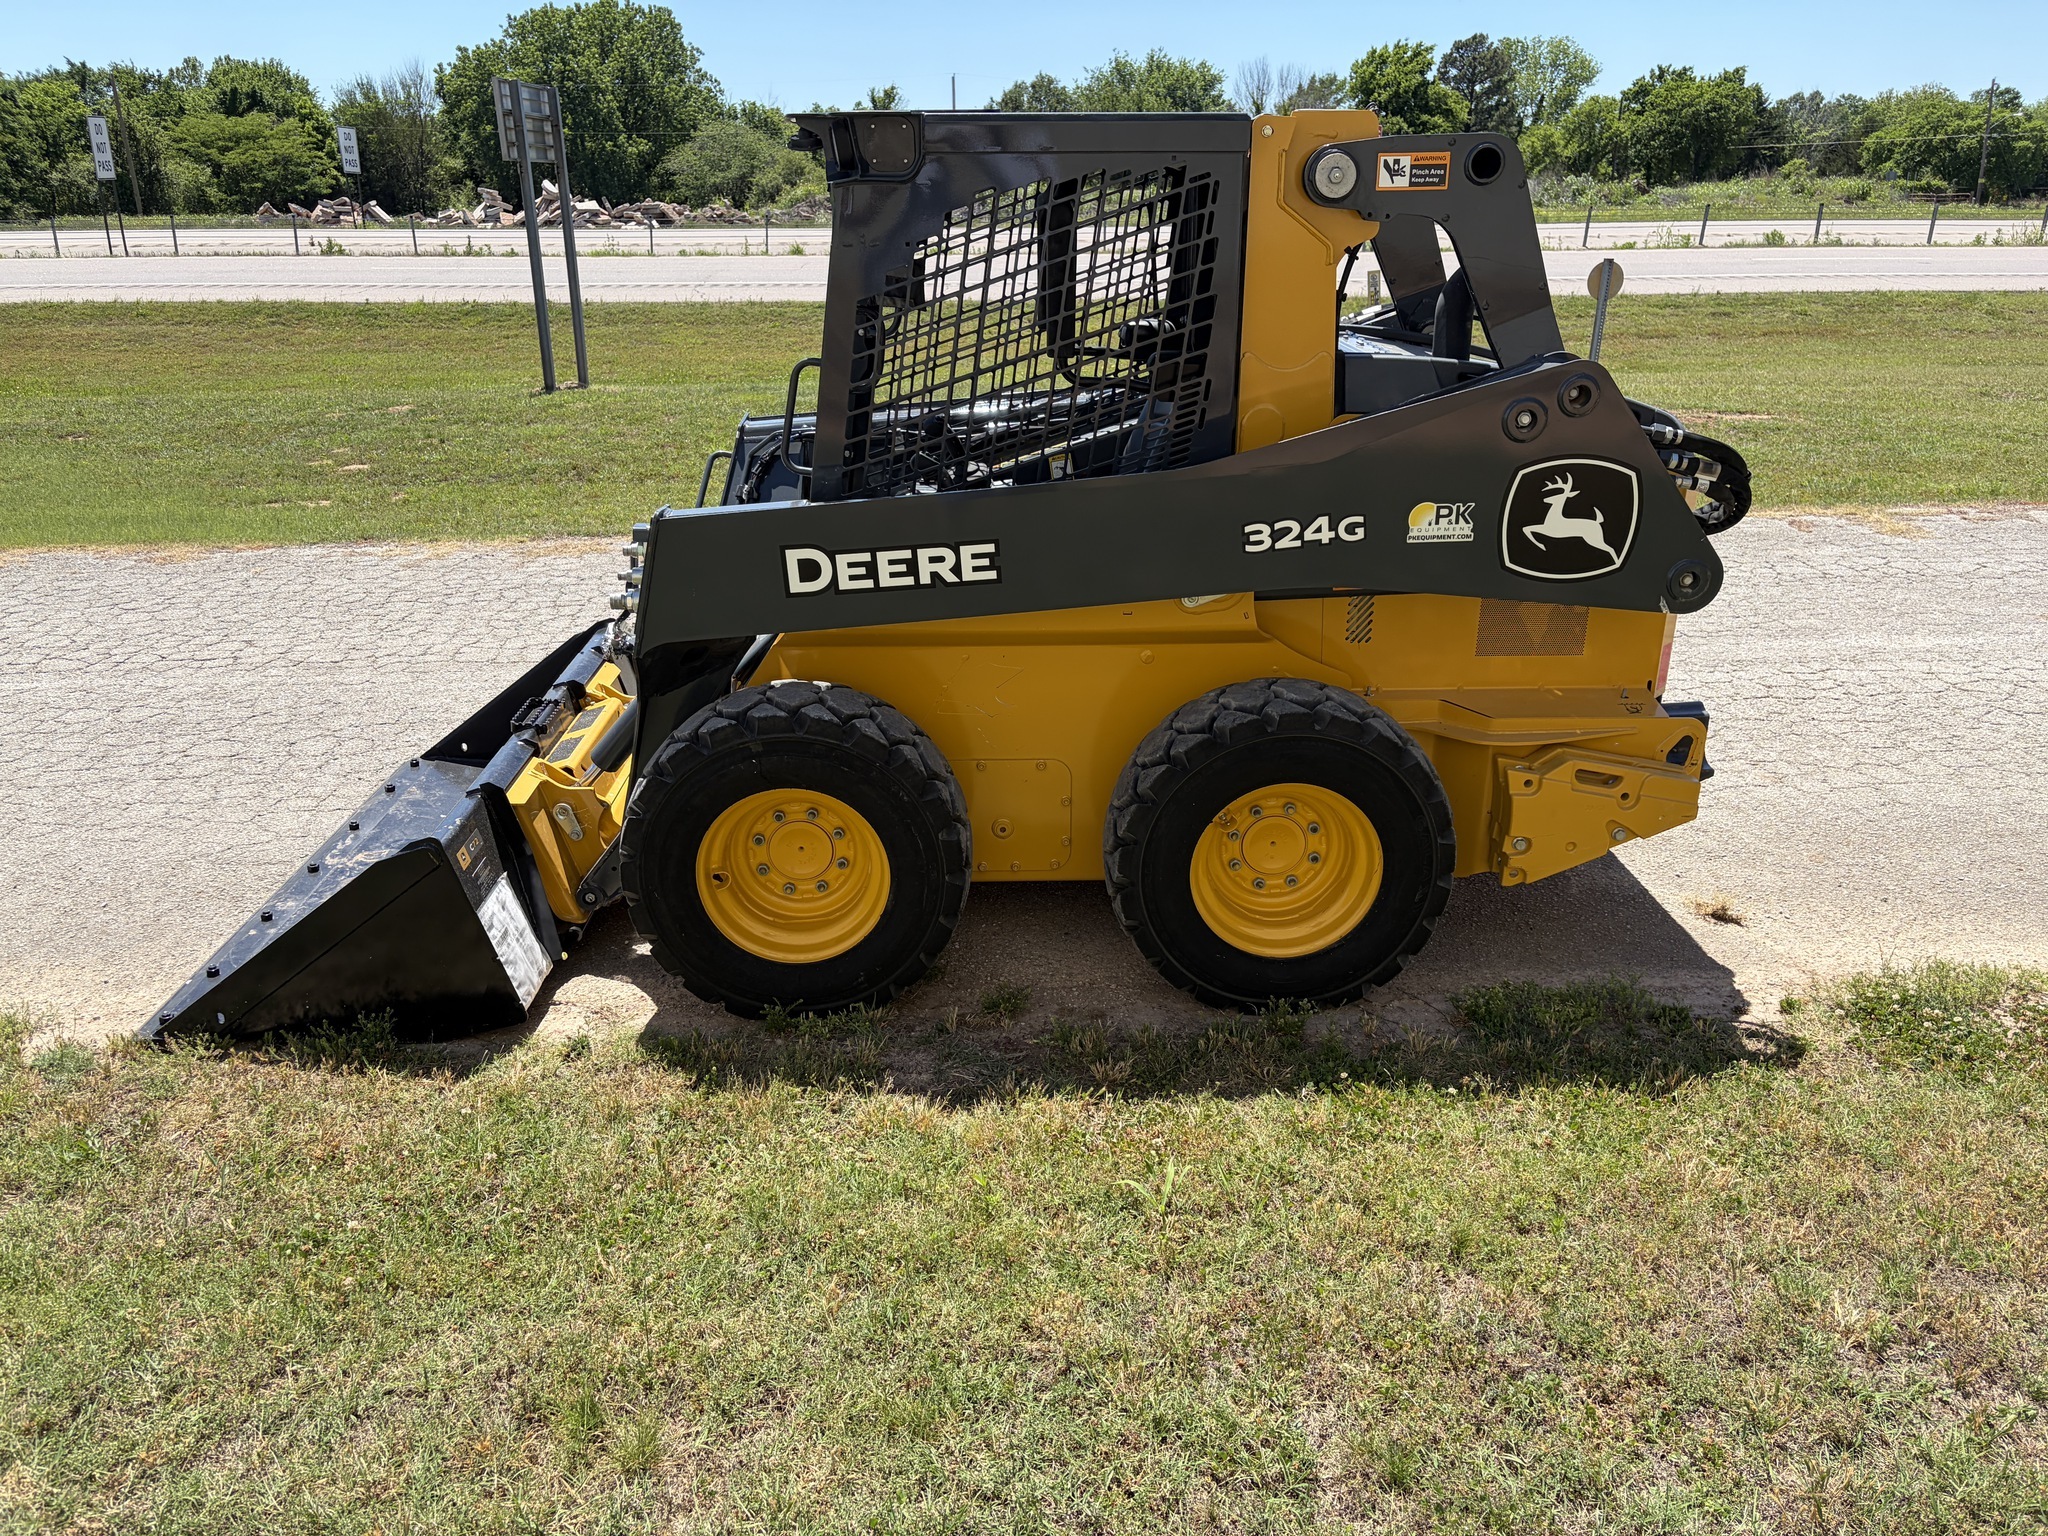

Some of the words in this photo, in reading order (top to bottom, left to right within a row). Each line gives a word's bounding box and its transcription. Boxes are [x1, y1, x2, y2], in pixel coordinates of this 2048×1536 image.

[94, 123, 103, 135] DO
[343, 131, 352, 141] DO
[96, 142, 107, 154] NOT
[343, 145, 355, 155] NOT
[97, 160, 112, 172] PASS
[344, 158, 358, 168] PASS
[1244, 515, 1365, 553] 324G
[784, 543, 998, 594] DEERE
